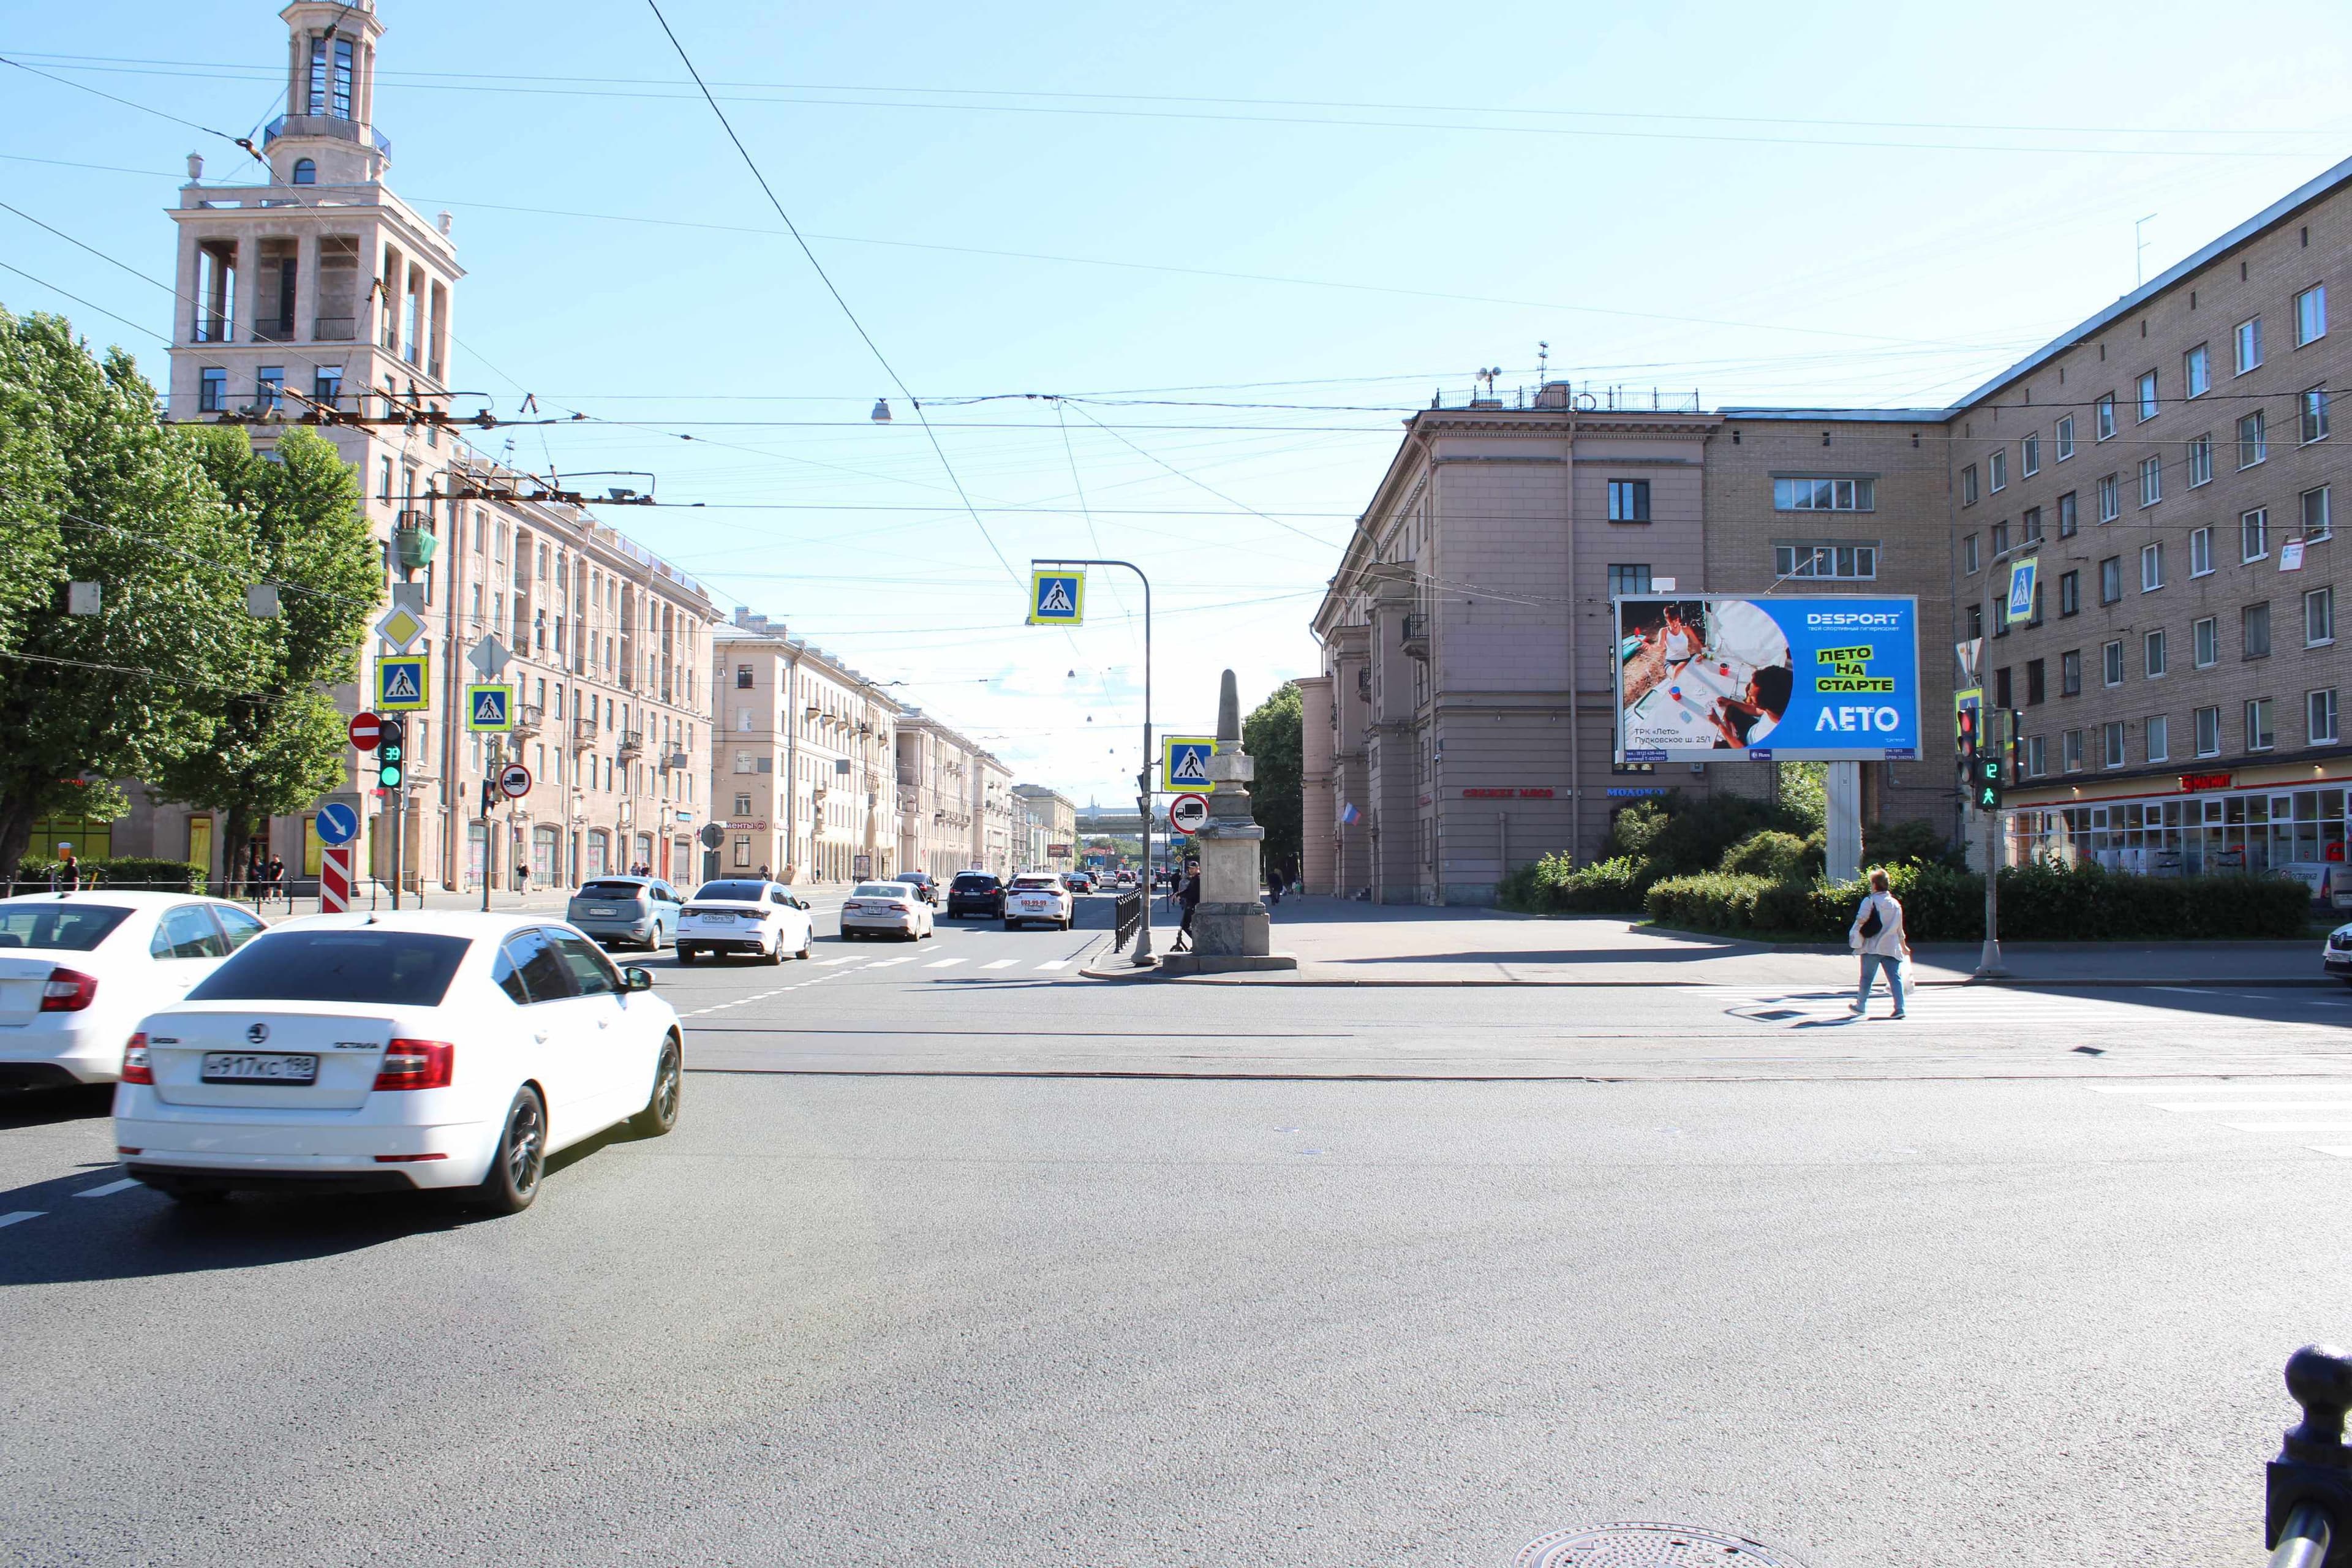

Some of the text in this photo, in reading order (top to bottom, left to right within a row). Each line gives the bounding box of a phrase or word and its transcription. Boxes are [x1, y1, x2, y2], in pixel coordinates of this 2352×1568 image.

[1807, 613, 1899, 625] DESPORT
[1819, 647, 1871, 662] ЛЕТО
[1836, 663, 1864, 675] НА
[1818, 680, 1893, 690] СТАРТЕ
[1815, 706, 1899, 731] ЛЕТО
[386, 748, 400, 760] 39
[1986, 764, 1997, 778] 12
[2194, 774, 2230, 790] МАГНИТ
